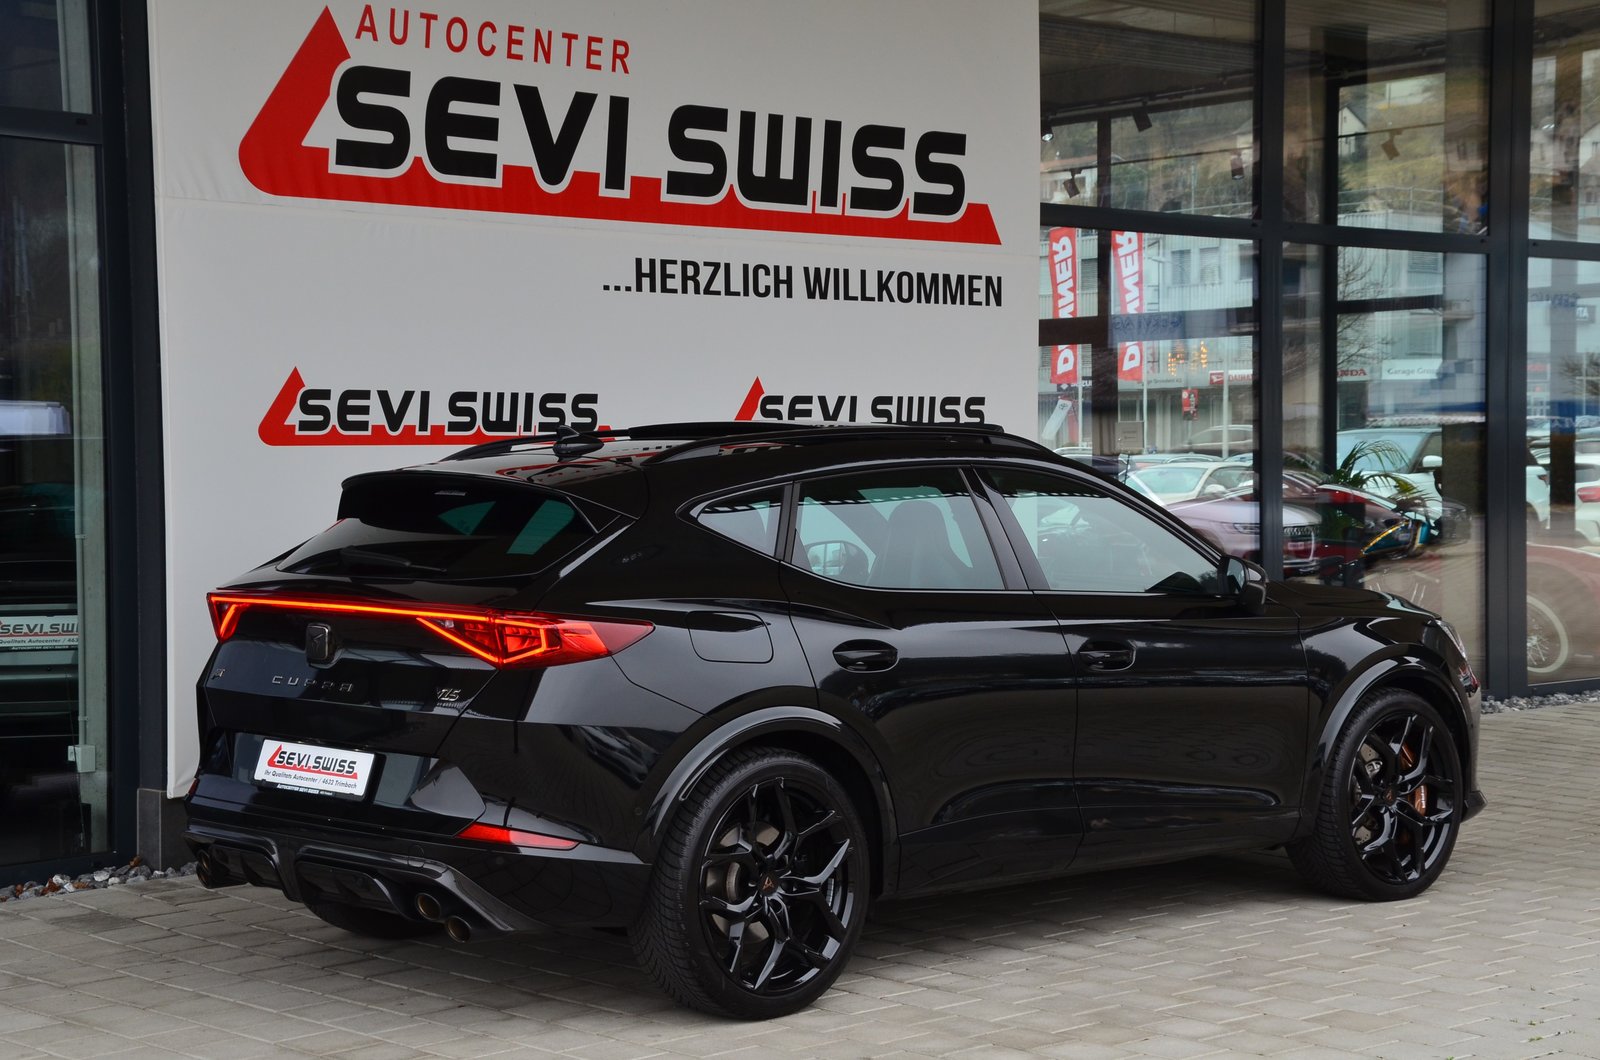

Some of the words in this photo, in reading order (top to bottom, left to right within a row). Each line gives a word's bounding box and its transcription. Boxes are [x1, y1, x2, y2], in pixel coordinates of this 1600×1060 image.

[355, 4, 630, 74] AUTOCENTER
[335, 65, 630, 191] SEVI
[666, 104, 967, 216] SWISS
[803, 266, 1002, 307] WILLKOMMEN
[298, 389, 430, 432] SEVI
[448, 391, 598, 432] SWISS
[760, 395, 858, 422] SEVI
[870, 396, 986, 424] SWISS
[0, 623, 43, 634] SEVI
[277, 751, 311, 767] SEVI
[312, 755, 357, 775] SWISS
[293, 773, 318, 783] Autocenter
[334, 780, 357, 789] Trimbach
